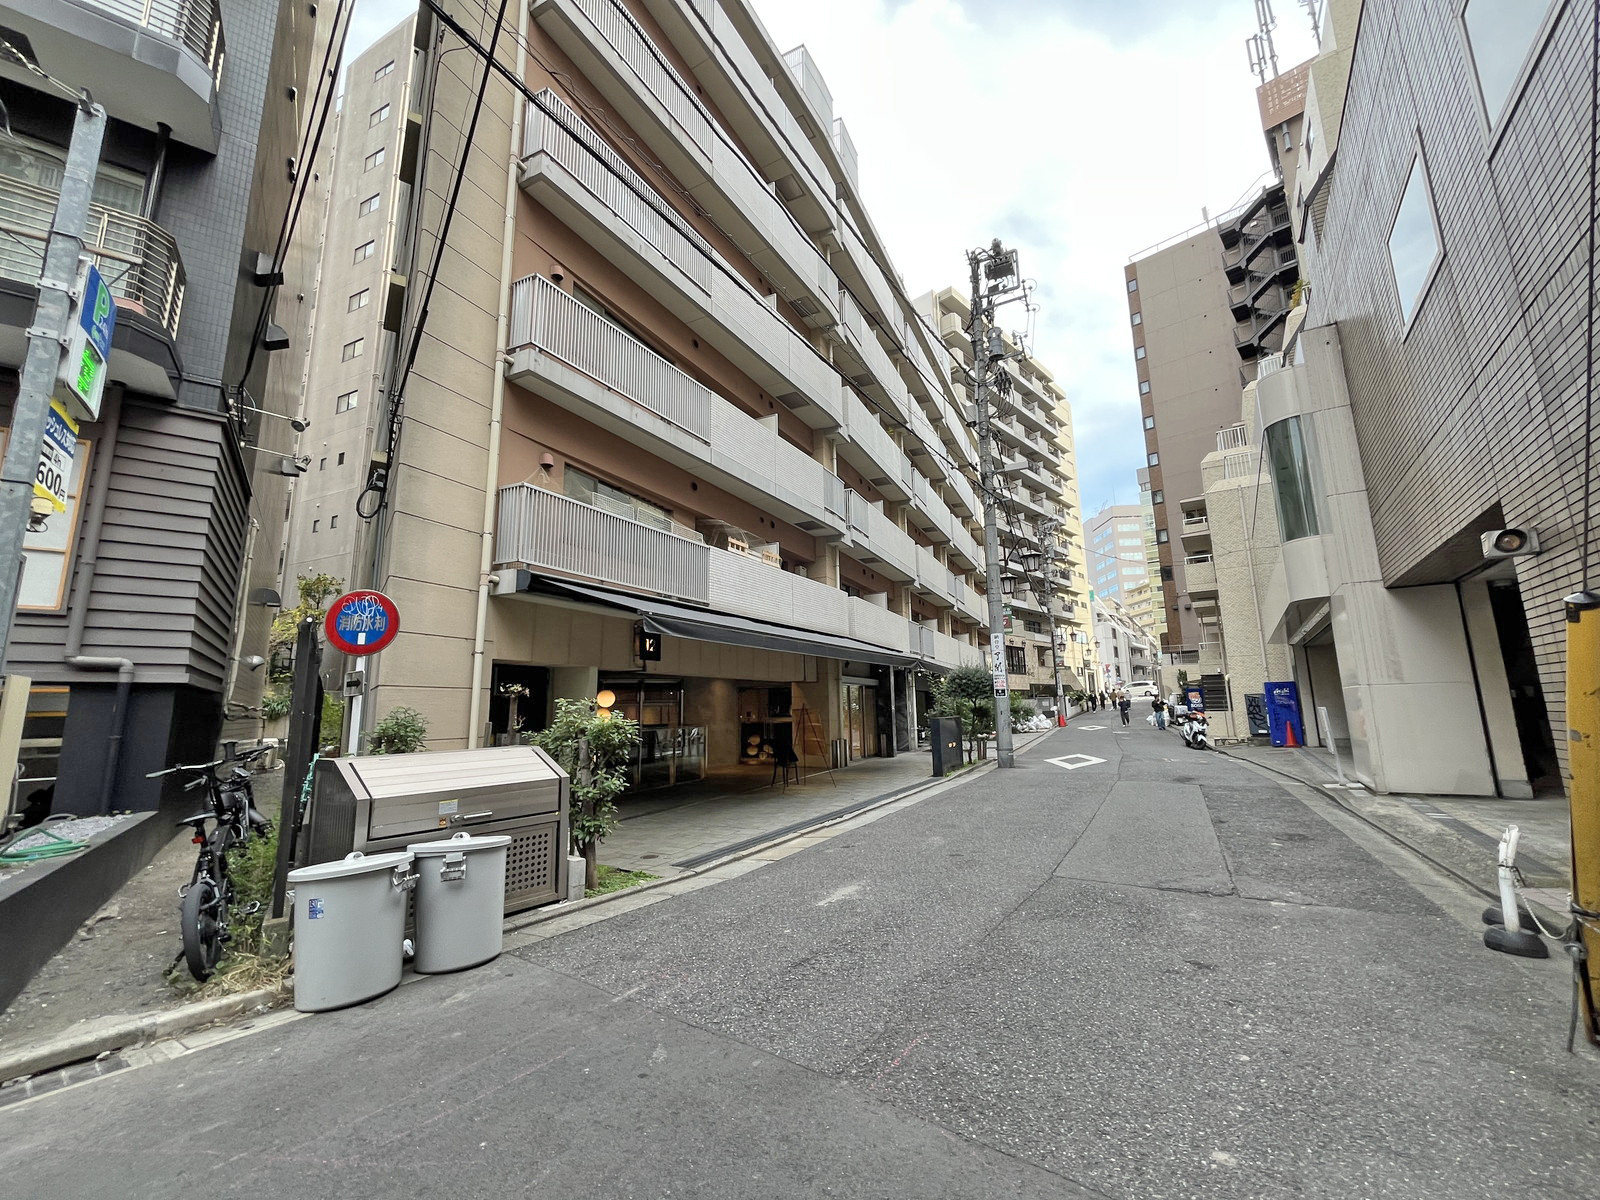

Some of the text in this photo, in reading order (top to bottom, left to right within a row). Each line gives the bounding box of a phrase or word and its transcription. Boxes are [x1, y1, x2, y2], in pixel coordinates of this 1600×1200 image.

[93, 281, 110, 325] P
[339, 615, 386, 632] 消防水利
